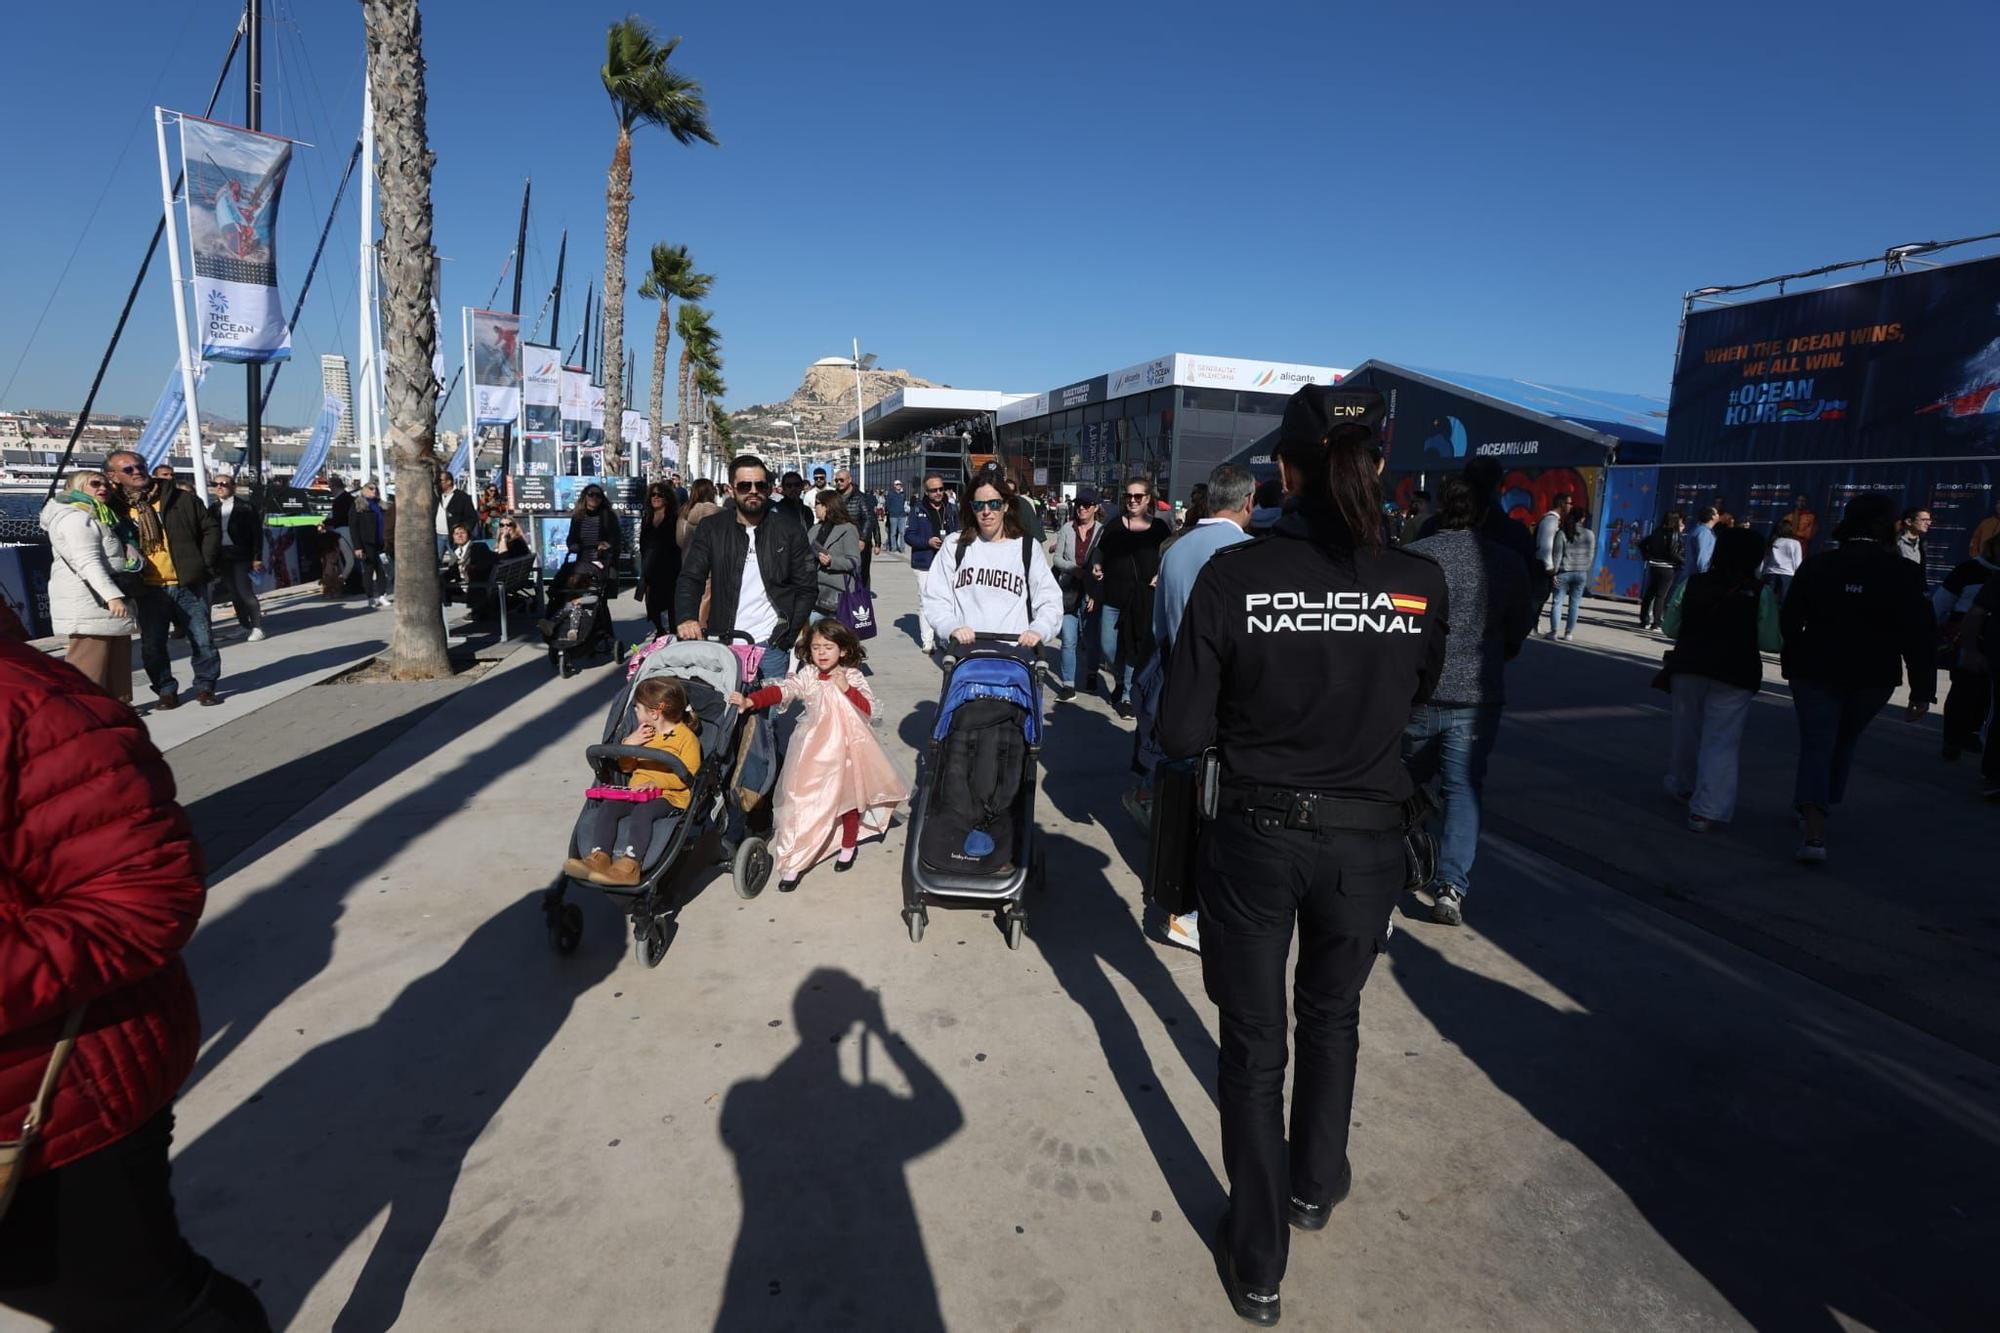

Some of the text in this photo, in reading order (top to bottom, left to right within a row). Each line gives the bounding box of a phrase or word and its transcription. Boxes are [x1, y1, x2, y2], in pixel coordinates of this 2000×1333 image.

[209, 312, 229, 323] THE
[210, 321, 254, 334] OCEAN
[210, 331, 240, 341] RACE
[1704, 323, 1905, 364] WHEN THE OCEAN WINS,
[1744, 352, 1844, 377] WE ALL WIN.
[1280, 371, 1315, 383] alicante
[1729, 378, 1814, 405] #OCEAN
[1334, 406, 1365, 417] CNP
[1936, 482, 1992, 490] Simon Fisher
[955, 566, 1024, 597] LOS ANGELES
[1247, 613, 1422, 634] NACIONAL
